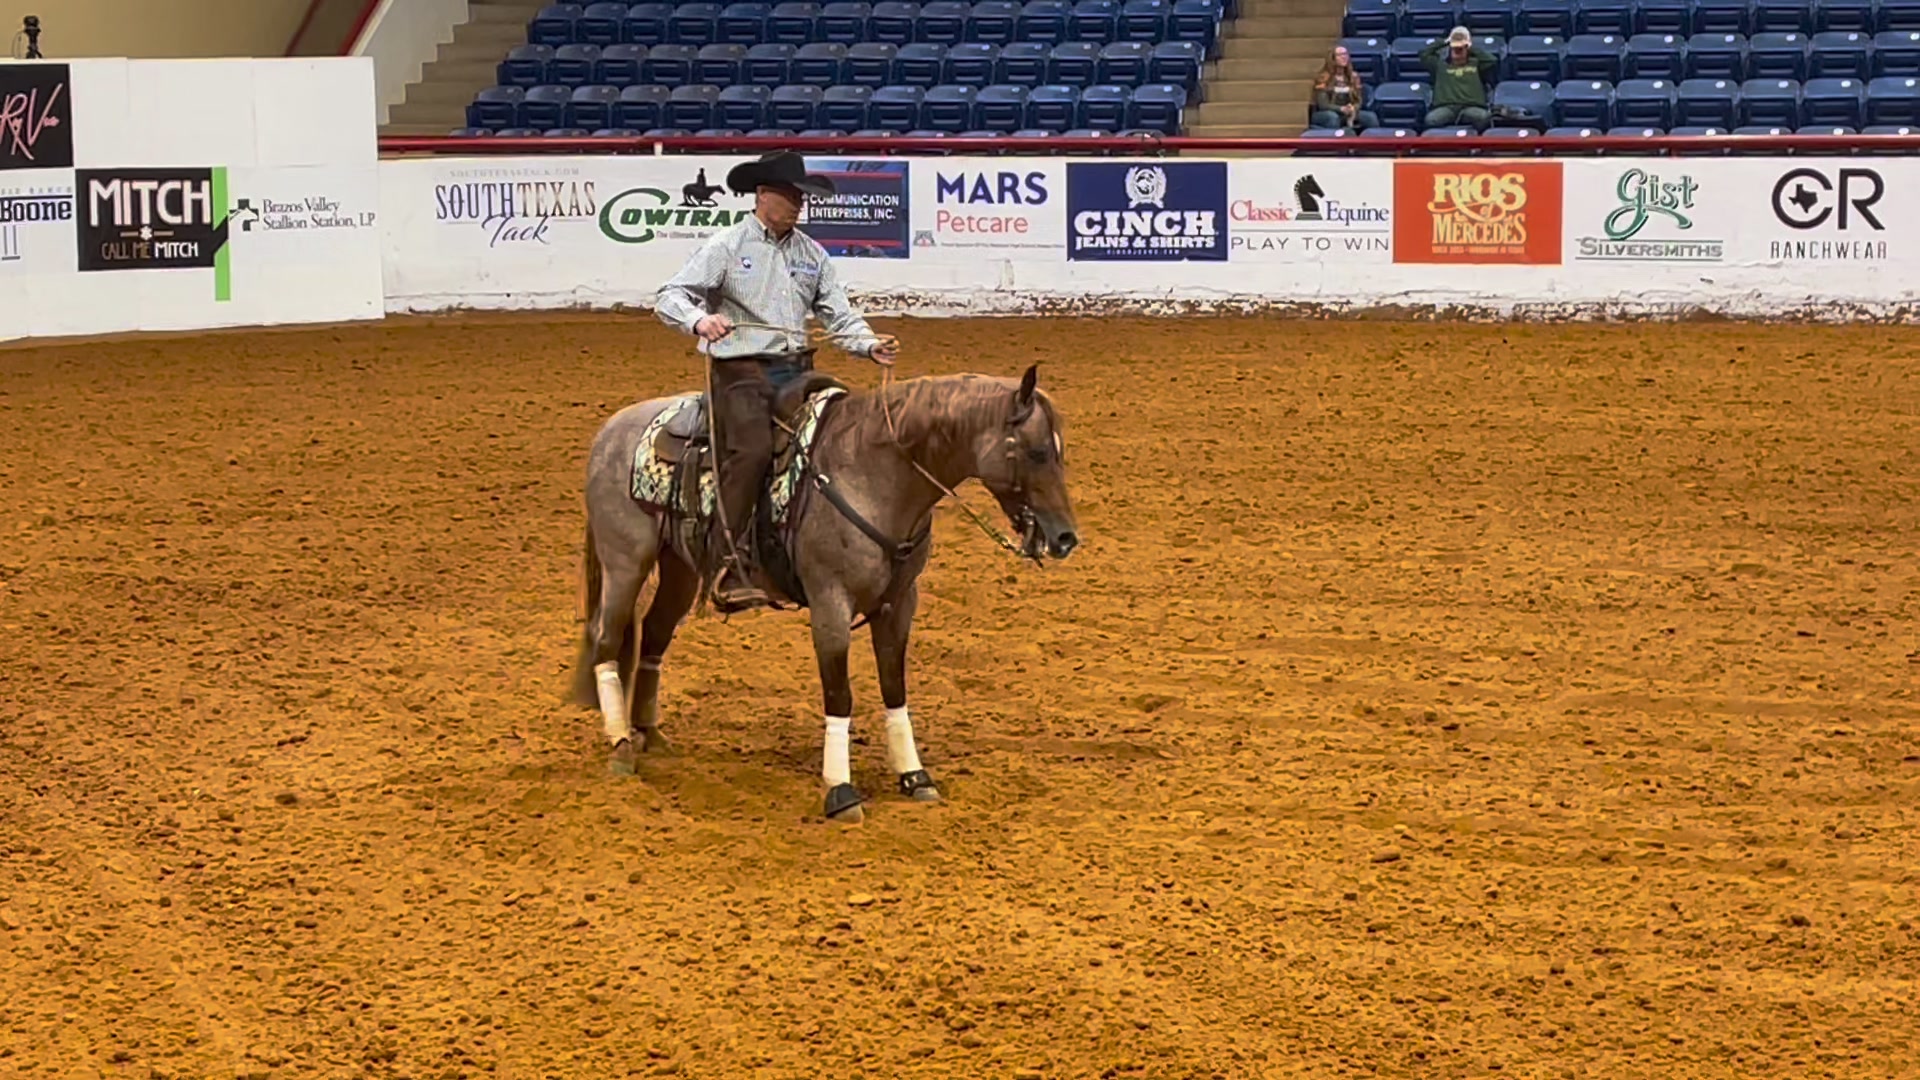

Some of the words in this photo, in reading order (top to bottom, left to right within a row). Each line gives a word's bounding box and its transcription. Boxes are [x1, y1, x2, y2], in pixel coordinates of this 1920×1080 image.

[936, 171, 1048, 205] MARS
[1428, 173, 1527, 213] RIOS
[89, 178, 211, 227] MITCH
[263, 198, 304, 213] Brazos
[304, 196, 340, 212] Valley
[809, 206, 871, 220] ENTERPRISES,
[874, 208, 896, 219] INC.
[1230, 200, 1293, 221] Classic
[1325, 200, 1389, 226] Equine
[1604, 168, 1699, 241] Gist
[263, 215, 307, 230] Stallion
[311, 212, 357, 229] Station,
[360, 212, 375, 226] LP
[481, 213, 550, 248] Tack
[936, 209, 1028, 233] Petcare
[1073, 210, 1216, 236] CINCH
[102, 242, 129, 260] CALL
[133, 242, 151, 258] ME
[155, 242, 199, 258] MITCH
[1075, 236, 1129, 250] JEANS
[1132, 236, 1146, 248] &
[1150, 236, 1215, 248] SHIRTS
[1231, 238, 1289, 250] PLAY
[1302, 237, 1331, 250] TO
[1345, 238, 1389, 250] WIN
[1580, 237, 1723, 257] SILVERSMITHS
[1770, 241, 1887, 259] RANCHWEAR
